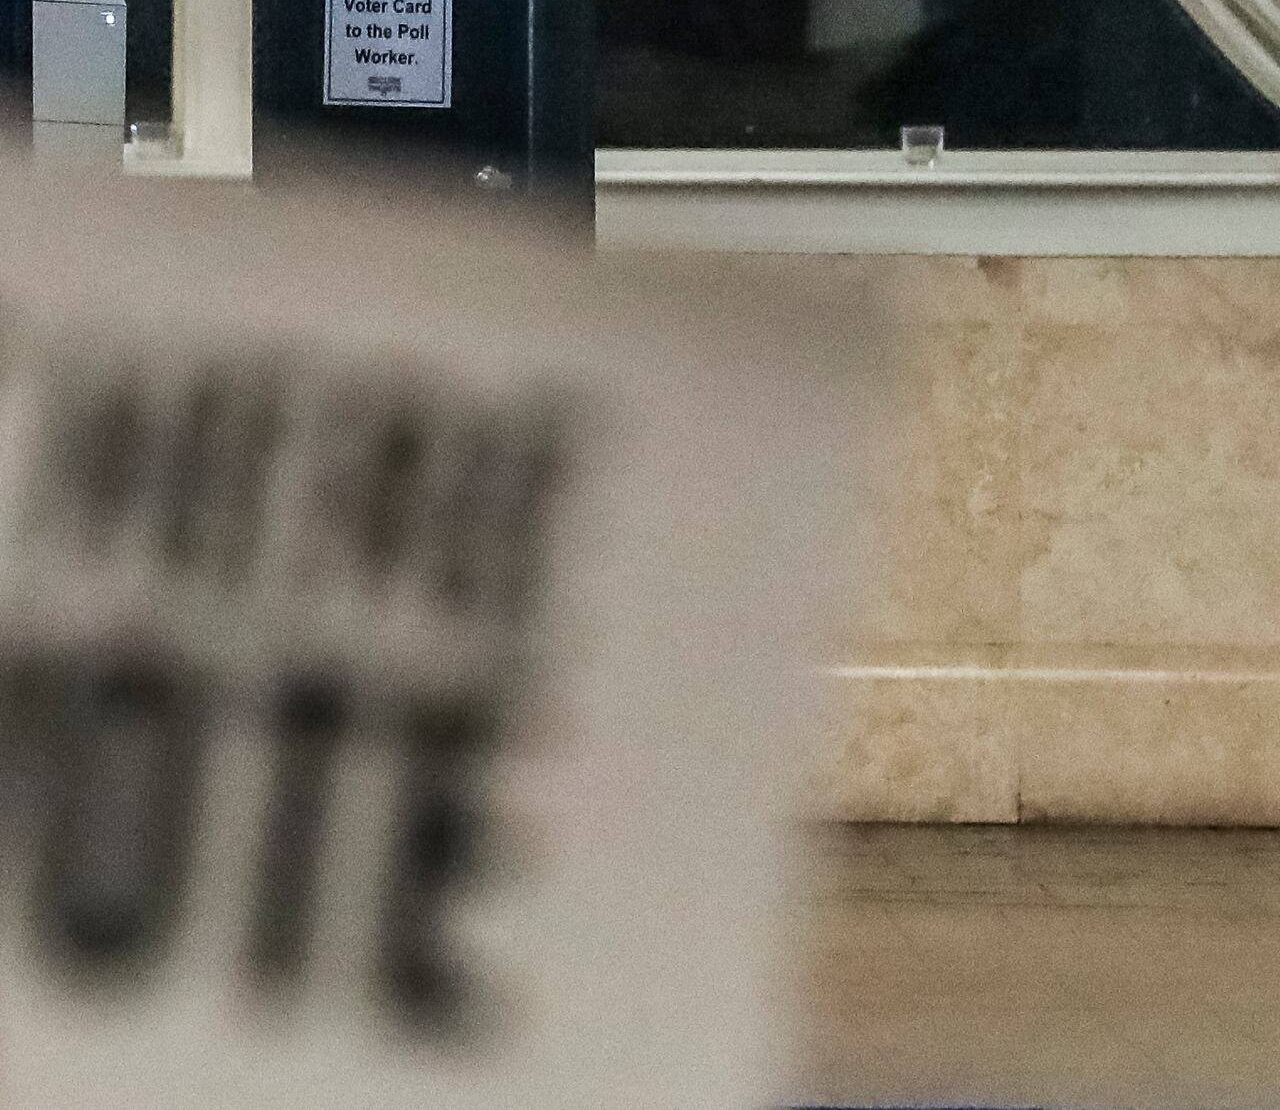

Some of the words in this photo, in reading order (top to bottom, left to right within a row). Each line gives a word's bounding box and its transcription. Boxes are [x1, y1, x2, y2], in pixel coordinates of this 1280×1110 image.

[393, 0, 432, 14] Card
[346, 25, 361, 38] to
[366, 25, 392, 39] the
[398, 25, 429, 39] Poll
[355, 48, 418, 65] Worker.
